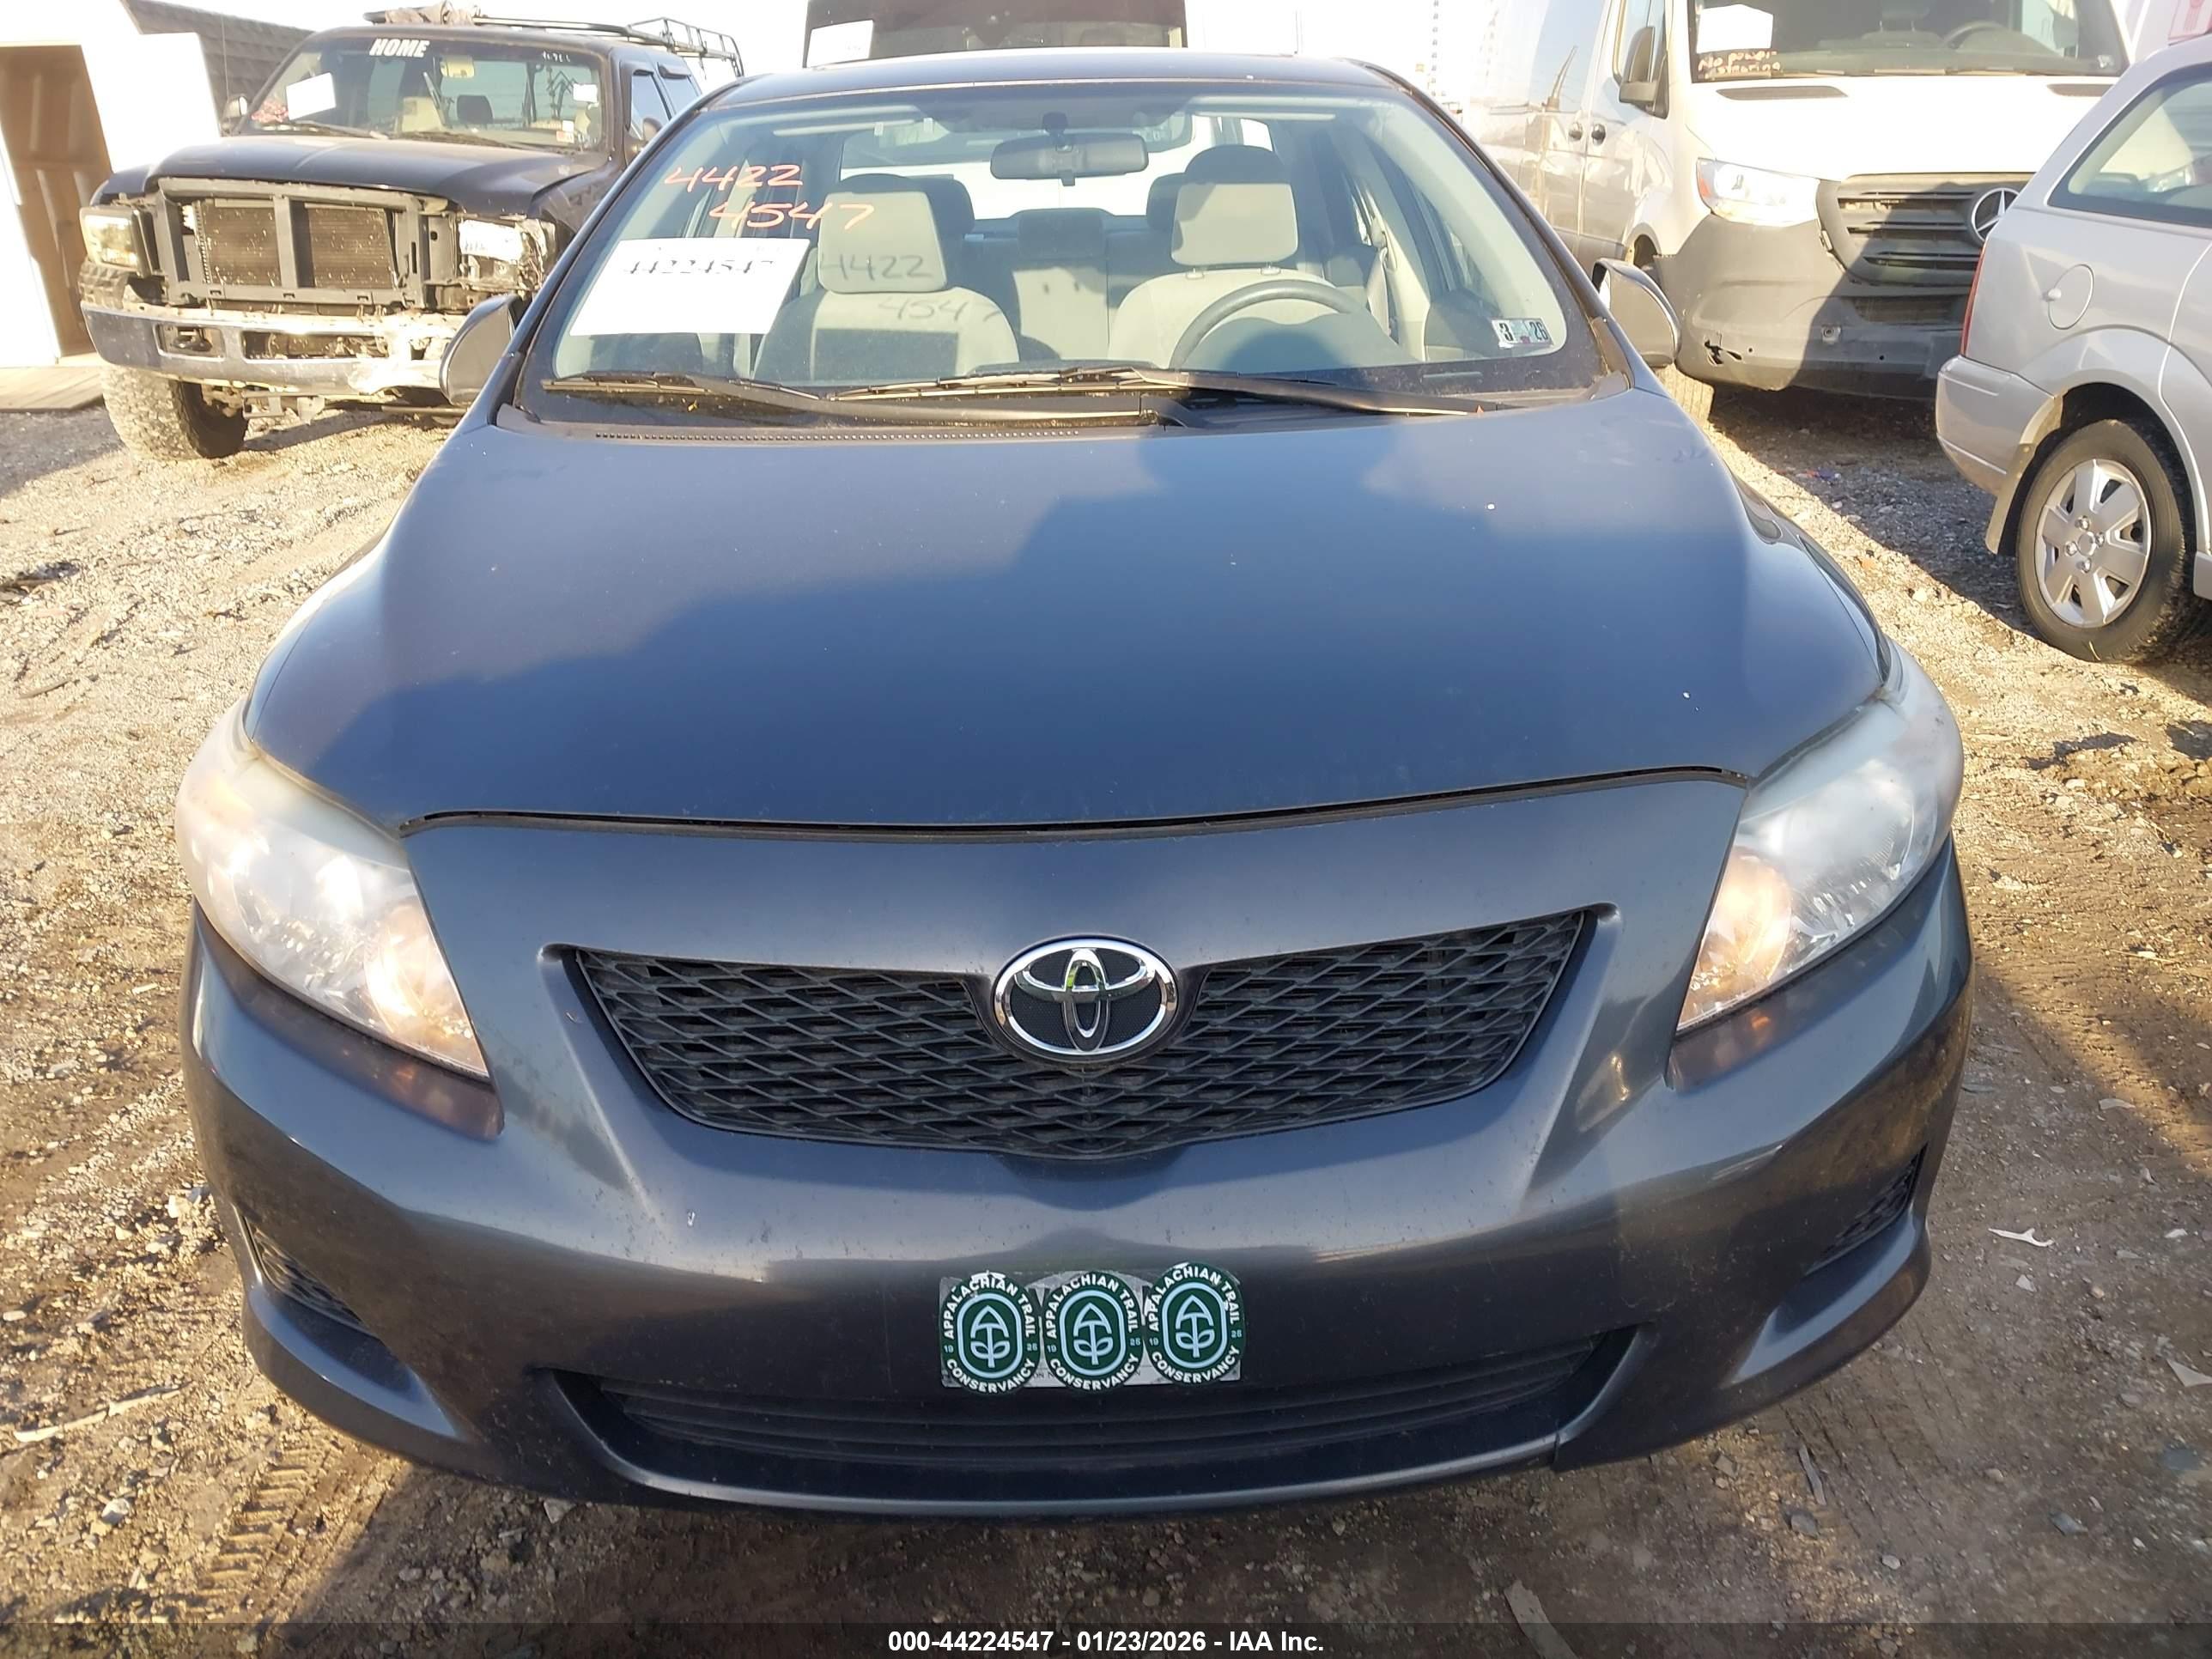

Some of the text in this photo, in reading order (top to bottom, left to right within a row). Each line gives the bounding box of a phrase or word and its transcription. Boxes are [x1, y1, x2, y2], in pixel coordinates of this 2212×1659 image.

[369, 38, 430, 58] HOME
[664, 163, 804, 192] 4422
[708, 201, 875, 231] 4547
[1498, 321, 1549, 342] 3 26
[943, 1275, 1036, 1340] APPALACHIAN TRAIL
[1045, 1273, 1139, 1340] APPALACHIAN TRAIL
[1148, 1266, 1240, 1332] APPALACHIAN TRAIL
[947, 1358, 1036, 1393] CONSERVANCY
[1050, 1352, 1139, 1390] CONSERVANCY
[1152, 1345, 1240, 1383] CONSERVANCY
